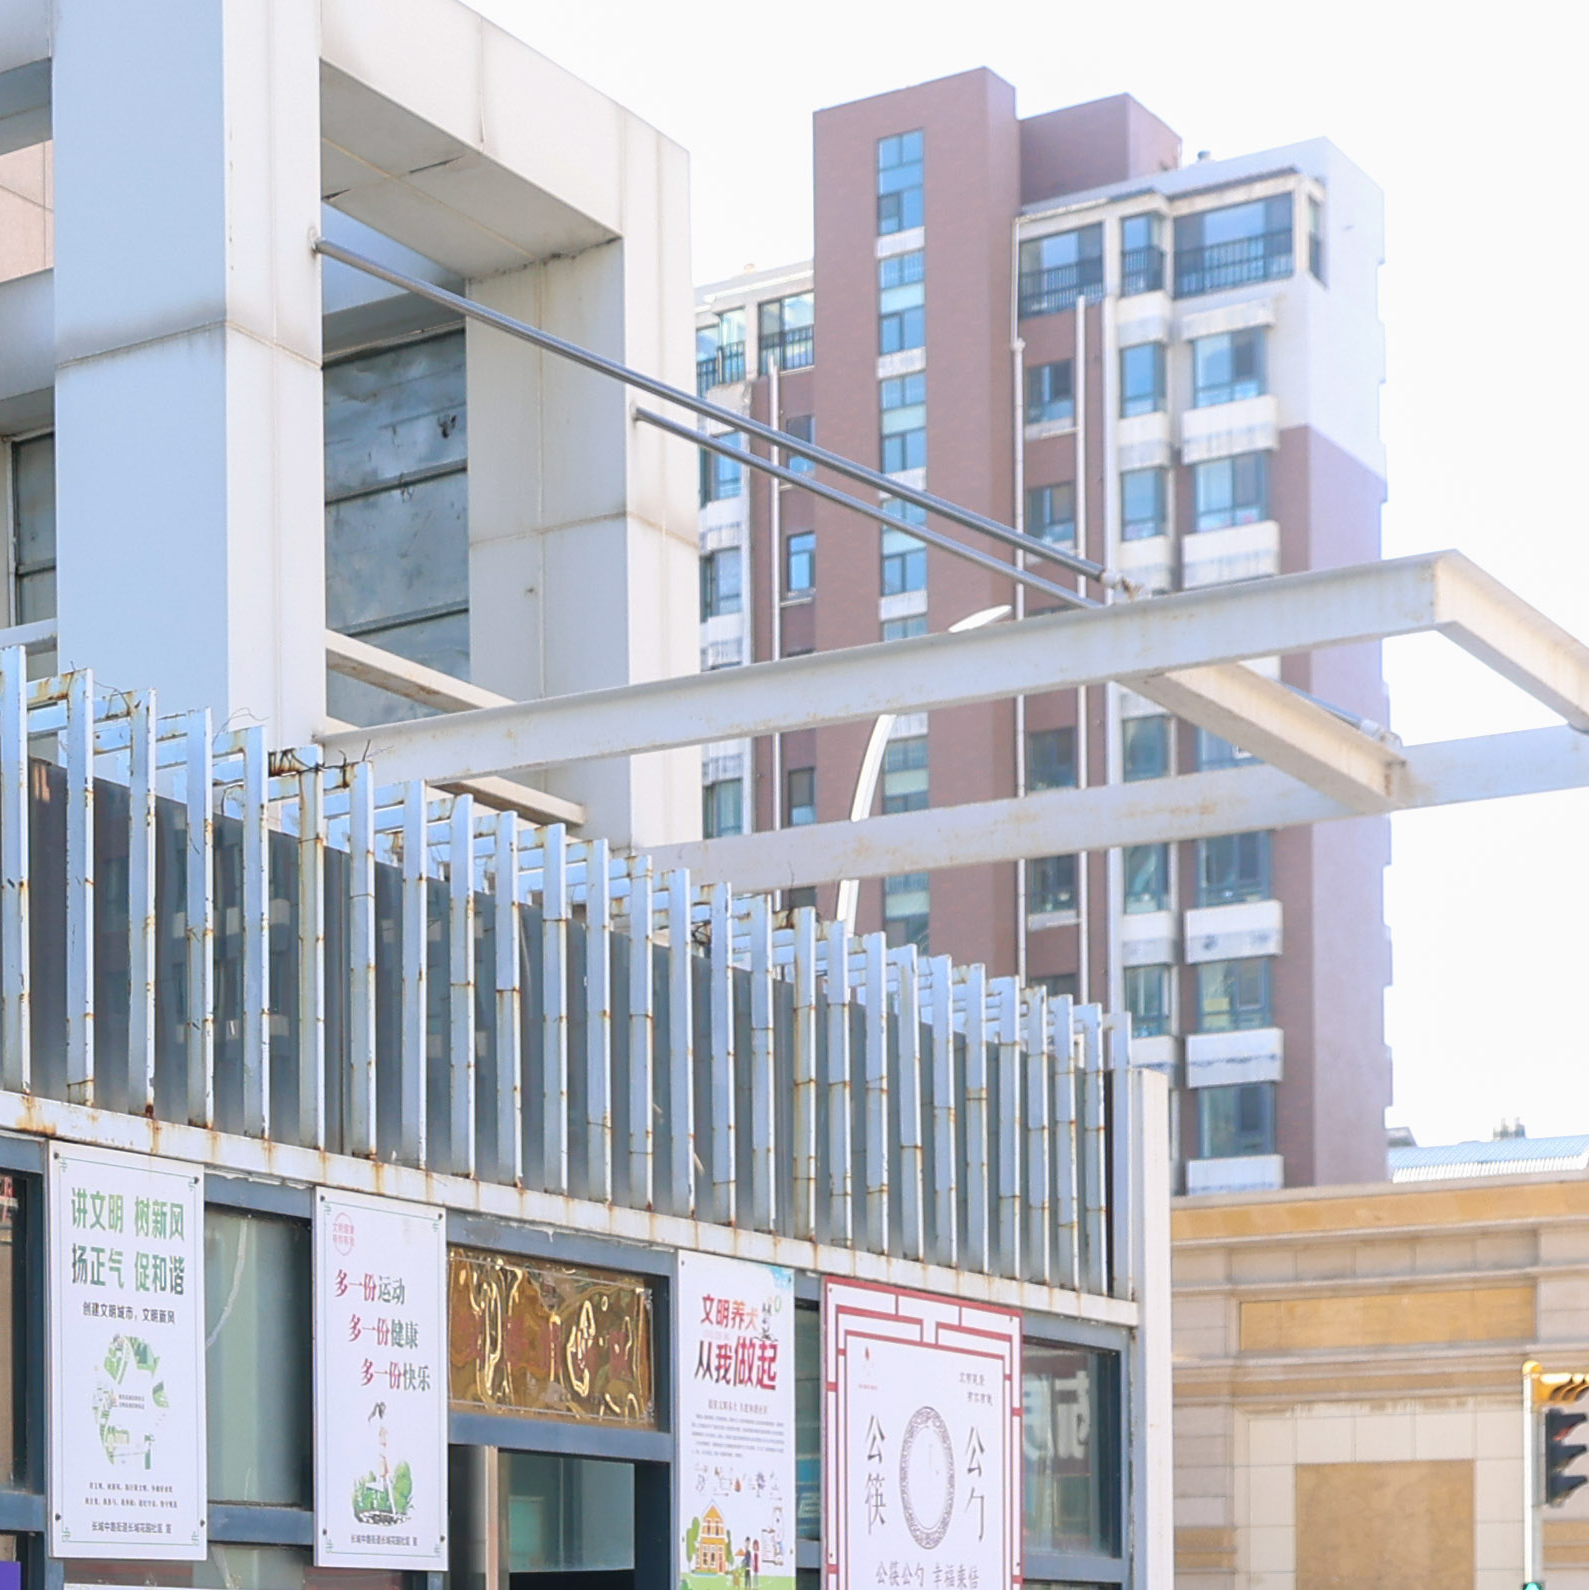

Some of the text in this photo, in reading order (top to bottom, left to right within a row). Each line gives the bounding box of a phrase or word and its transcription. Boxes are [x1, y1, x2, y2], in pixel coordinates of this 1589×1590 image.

[71, 1188, 184, 1240] 讲文明 树新风
[72, 1243, 185, 1295] 扬正气 促和谐
[336, 1269, 405, 1305] 多一份运动
[349, 1314, 418, 1349] 多一份健康
[700, 1294, 758, 1331] 文明养犬
[362, 1358, 430, 1391] 多一份快乐
[694, 1338, 778, 1391] 从我做起
[866, 1414, 886, 1535] 公筷
[966, 1424, 986, 1543] 公勺
